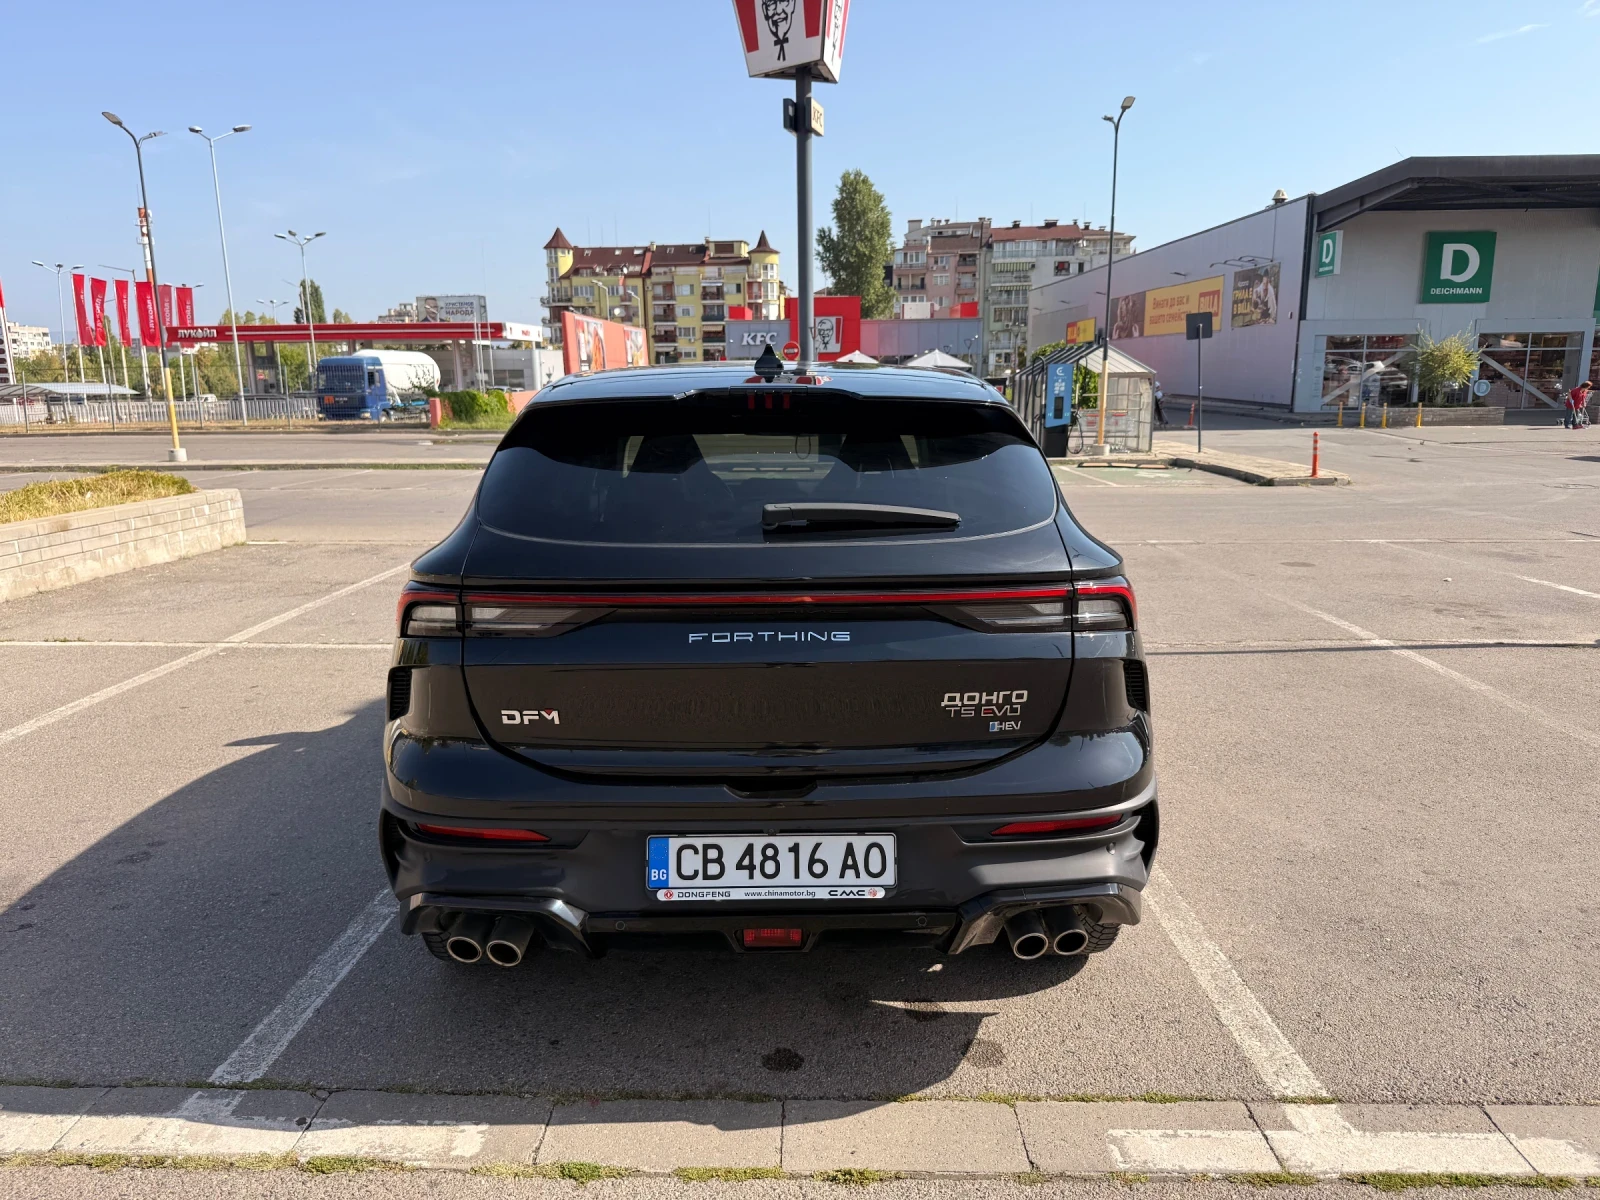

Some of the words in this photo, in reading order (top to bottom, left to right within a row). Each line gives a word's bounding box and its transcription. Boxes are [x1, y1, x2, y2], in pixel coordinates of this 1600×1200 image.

[812, 106, 823, 127] KFC
[1440, 243, 1480, 283] D
[1430, 287, 1483, 295] DEICHMANN
[177, 329, 217, 338] ЛУКОЙЛ
[741, 332, 777, 346] KFC
[688, 631, 850, 643] FORTHING
[941, 690, 1028, 706] ДОНГО
[501, 709, 560, 725] DFM
[946, 706, 975, 717] T5
[981, 704, 1021, 716] EVO
[996, 721, 1021, 730] HEV
[676, 843, 726, 881] CB
[735, 842, 829, 880] 4816
[839, 842, 887, 879] AO
[651, 869, 667, 881] BG
[744, 889, 816, 898] www.chinamotor.bg
